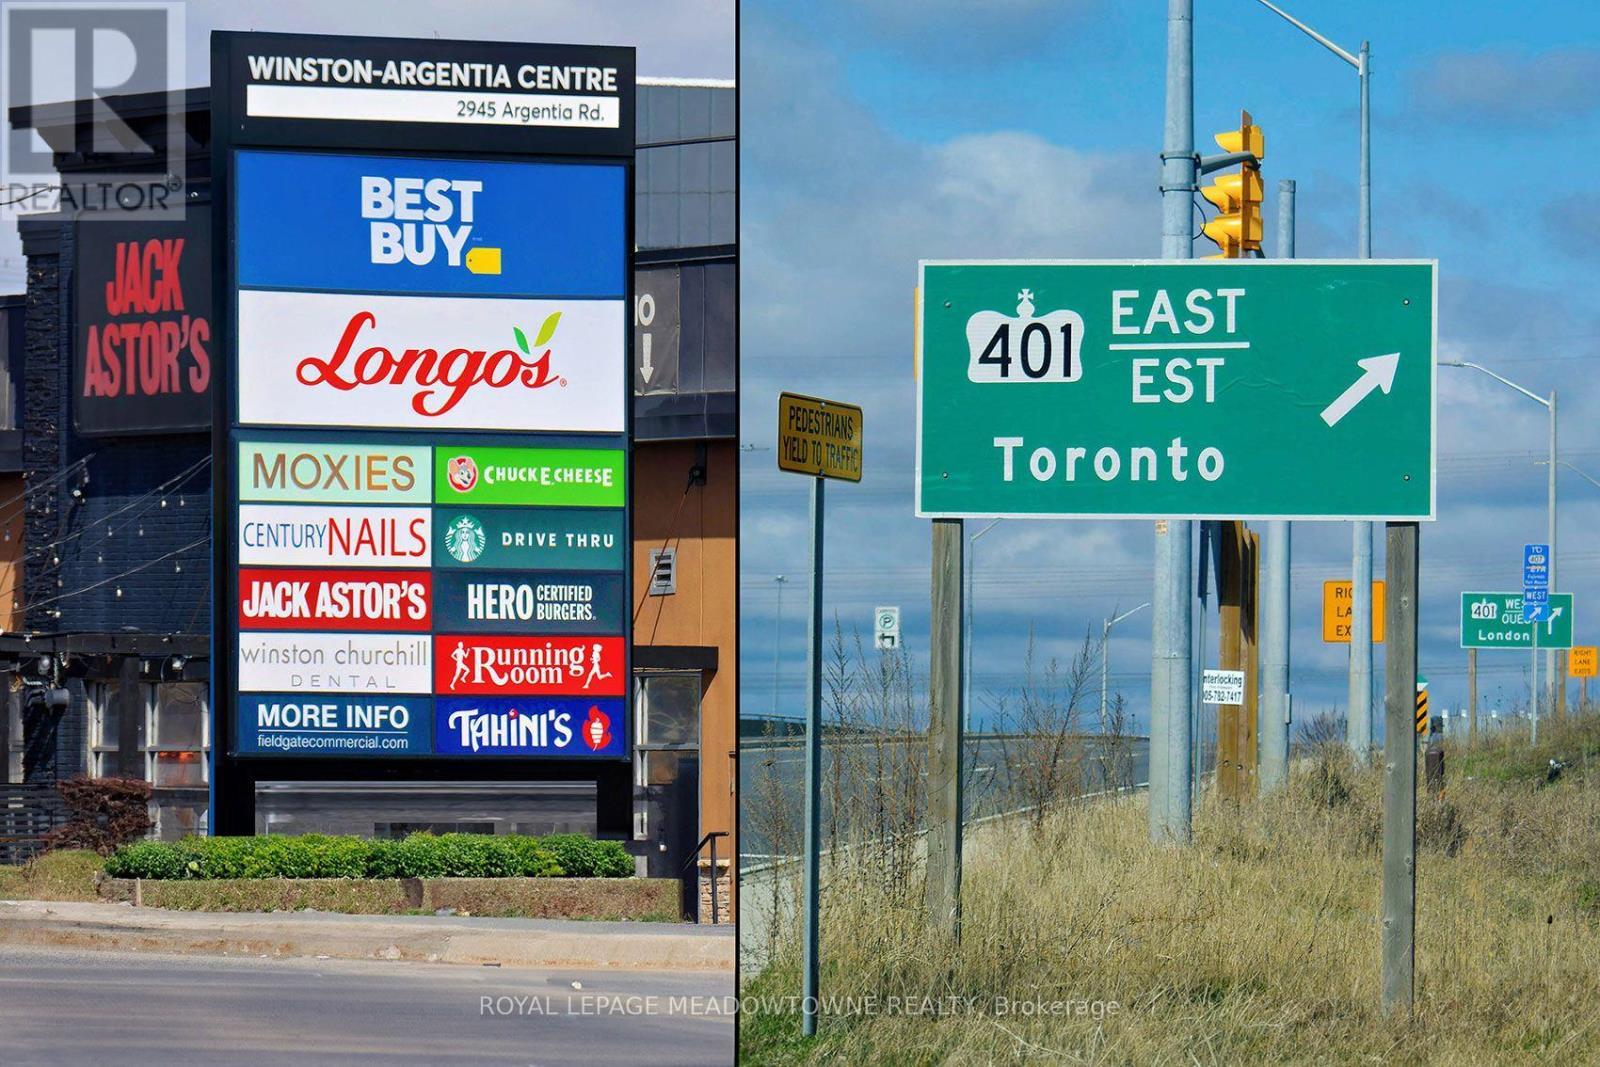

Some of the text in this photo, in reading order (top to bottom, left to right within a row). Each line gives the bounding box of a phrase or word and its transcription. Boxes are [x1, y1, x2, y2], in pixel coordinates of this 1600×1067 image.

[247, 55, 618, 92] WINSTON-ARGENTIA CENTRE
[456, 100, 606, 123] 2945 Argentia Rd.
[361, 176, 483, 223] BEST
[370, 221, 473, 267] BUY
[105, 238, 185, 316] JACK
[1111, 288, 1246, 335] EAST
[83, 314, 211, 398] ASTOR'S
[978, 322, 1073, 379] 401
[1131, 357, 1226, 404] EST
[788, 404, 854, 441] PEDESTRIANS
[783, 435, 858, 472] YIELD TO TRAFFIC
[993, 436, 1225, 482] Toronto
[252, 453, 416, 492] MOXIES
[484, 465, 538, 485] CHUCK
[554, 467, 613, 487] CHEESE
[243, 516, 427, 557] CENTURY NAILS
[502, 531, 614, 548] DRIVE THRU
[242, 579, 428, 620] JACK ASTOR'S
[467, 583, 535, 620] HERO
[536, 584, 593, 602] CERTIFIED
[1473, 604, 1496, 618] 401
[1526, 591, 1546, 600] WEST
[1335, 625, 1352, 637] EX
[1478, 629, 1531, 641] London
[240, 639, 427, 666] winston churchill
[471, 641, 586, 686] Running
[290, 674, 396, 689] DENTAL
[257, 703, 410, 729] MORE INFO
[257, 734, 409, 750] fieldgatecommercial.com
